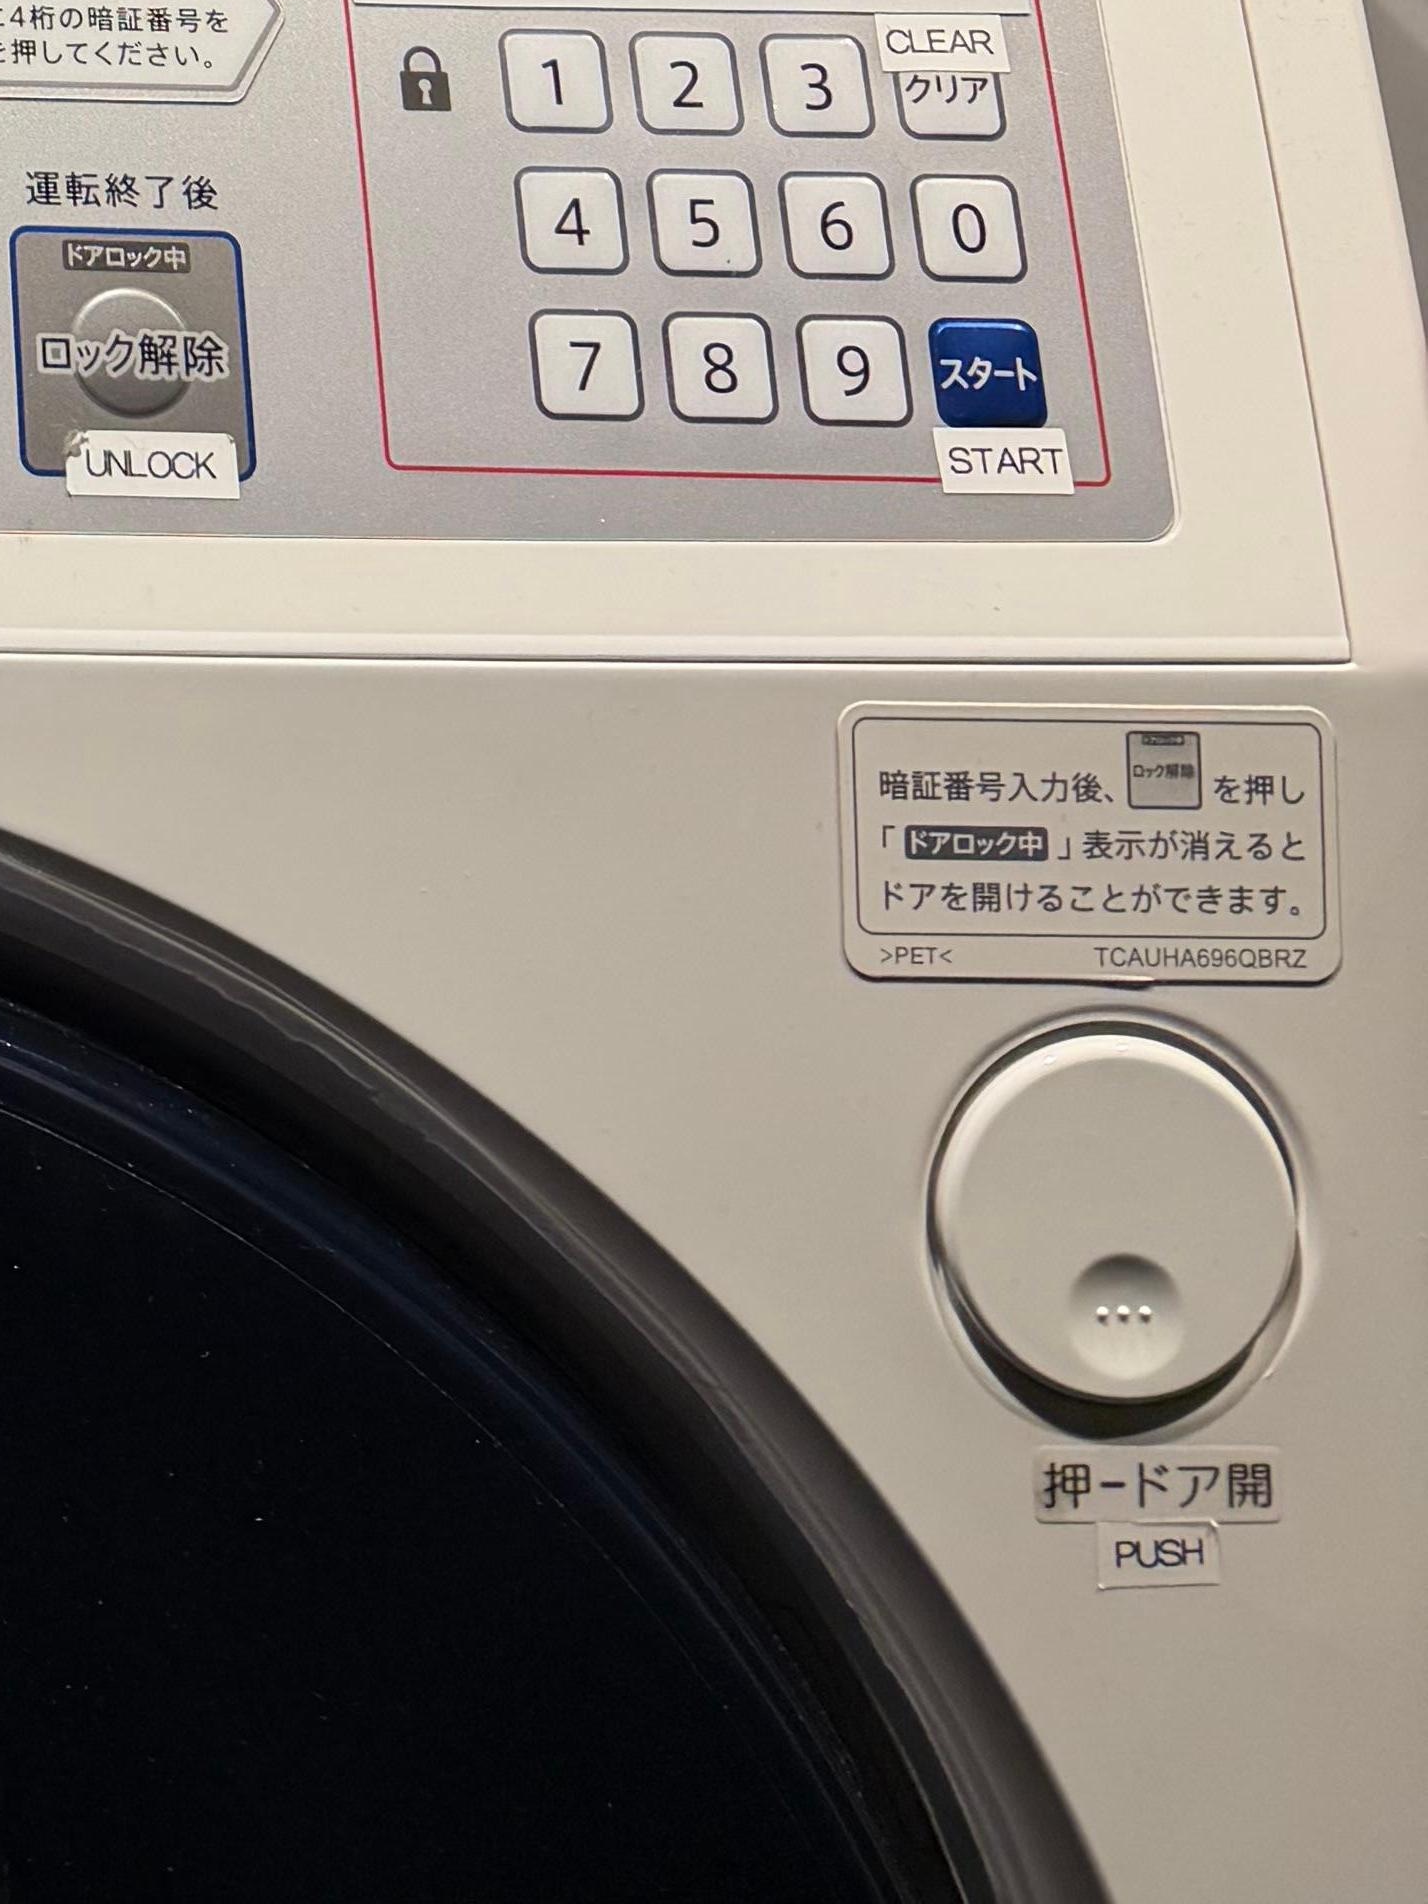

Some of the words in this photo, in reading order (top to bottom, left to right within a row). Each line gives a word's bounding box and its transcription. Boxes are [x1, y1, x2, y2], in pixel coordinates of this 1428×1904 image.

[885, 28, 994, 56] CLEAR
[540, 60, 564, 106] 1
[670, 62, 704, 109] 2
[804, 64, 833, 110] 3
[905, 74, 989, 105] クリア
[25, 172, 219, 211] 運転終了後
[554, 198, 591, 246] 4
[690, 199, 721, 247] 5
[820, 202, 854, 250] 6
[951, 203, 986, 254] 0
[66, 244, 187, 270] ドアロック中
[38, 337, 226, 379] ロック解除
[570, 342, 601, 391] 7
[702, 343, 738, 392] 8
[835, 345, 871, 395] 9
[939, 357, 1038, 390] スタート
[85, 450, 219, 479] UNLOCK
[949, 445, 1063, 475] START
[878, 771, 1116, 806] 暗証番号入力後、
[879, 882, 1305, 918] ドアを開けることができます。
[1093, 946, 1309, 970] TCAUHA696QBRZ
[1115, 1538, 1204, 1567] PUSH
